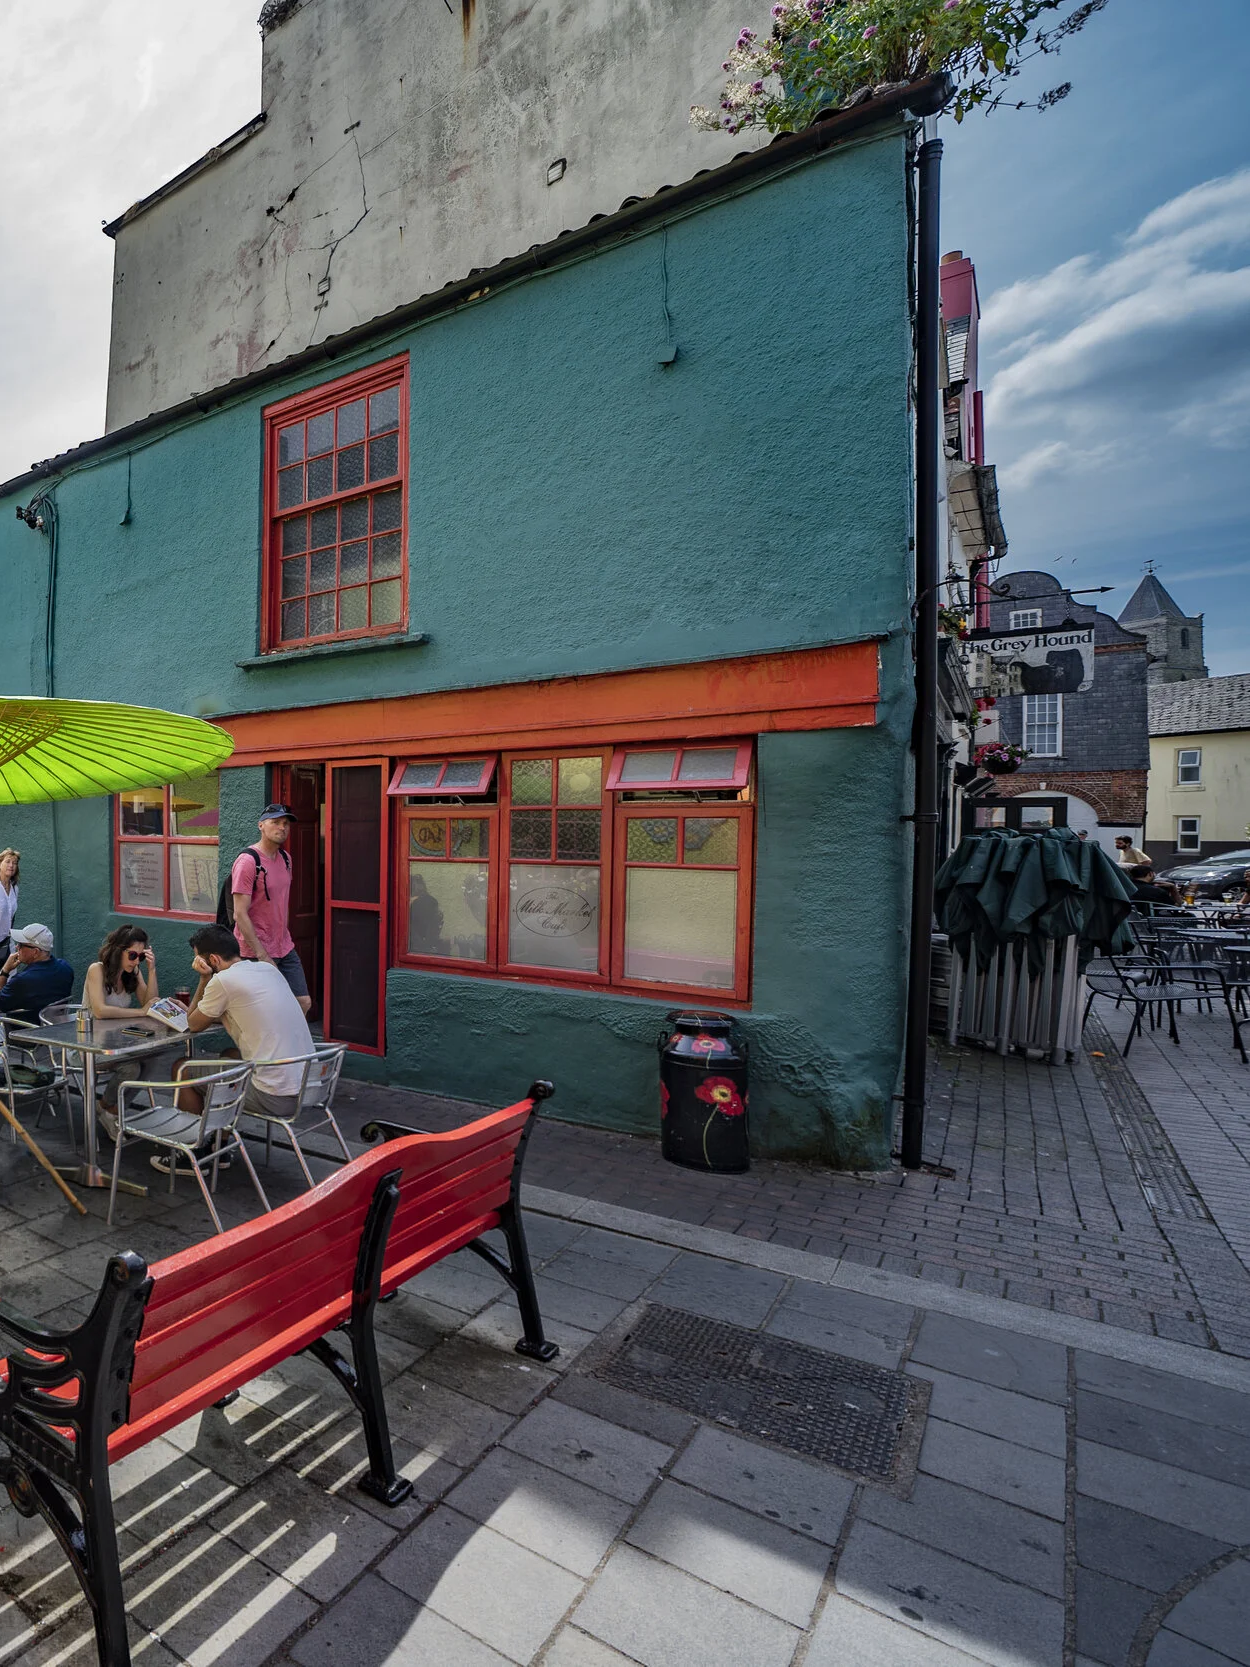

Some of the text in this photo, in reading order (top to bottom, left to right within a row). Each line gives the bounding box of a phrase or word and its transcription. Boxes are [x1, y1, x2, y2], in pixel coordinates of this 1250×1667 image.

[960, 632, 1092, 655] The Grey Hound
[513, 900, 596, 917] Milk Market
